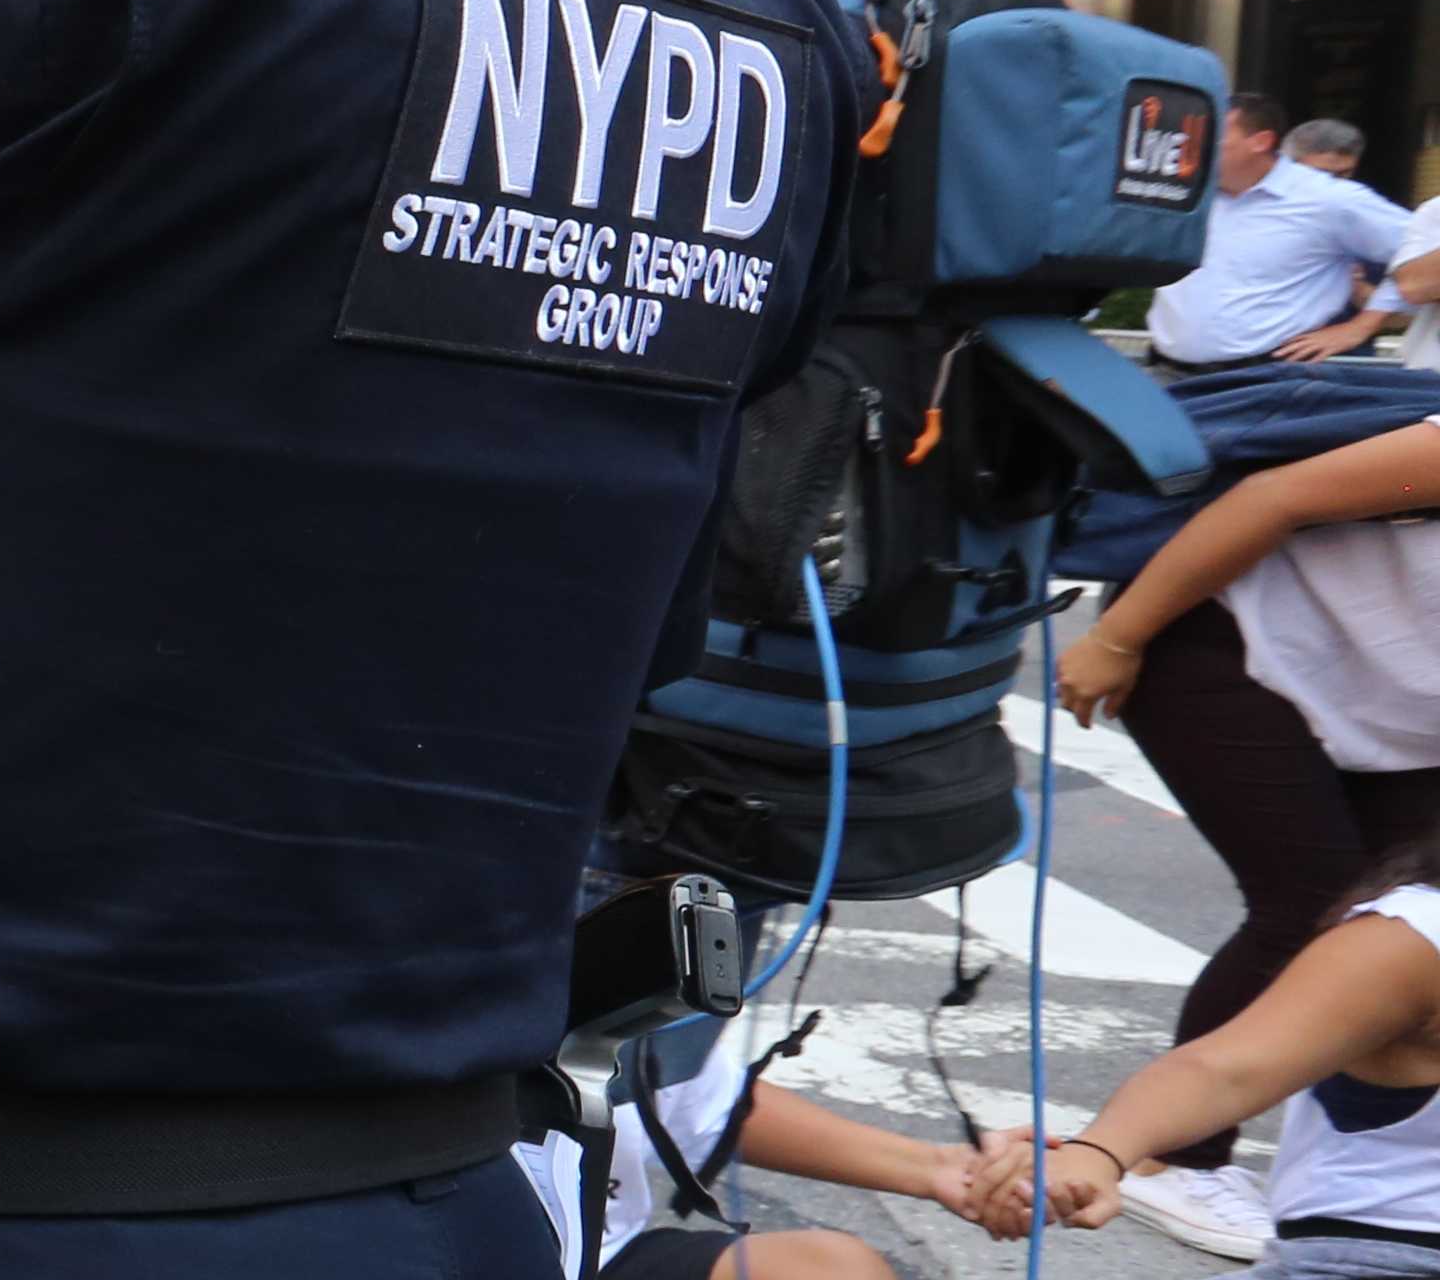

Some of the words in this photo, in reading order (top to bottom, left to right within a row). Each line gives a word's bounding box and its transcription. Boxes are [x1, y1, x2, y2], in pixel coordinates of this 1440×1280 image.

[382, 192, 618, 285] STRATEGIC
[624, 230, 773, 314] RESPONSE
[535, 284, 665, 356] GROUP
